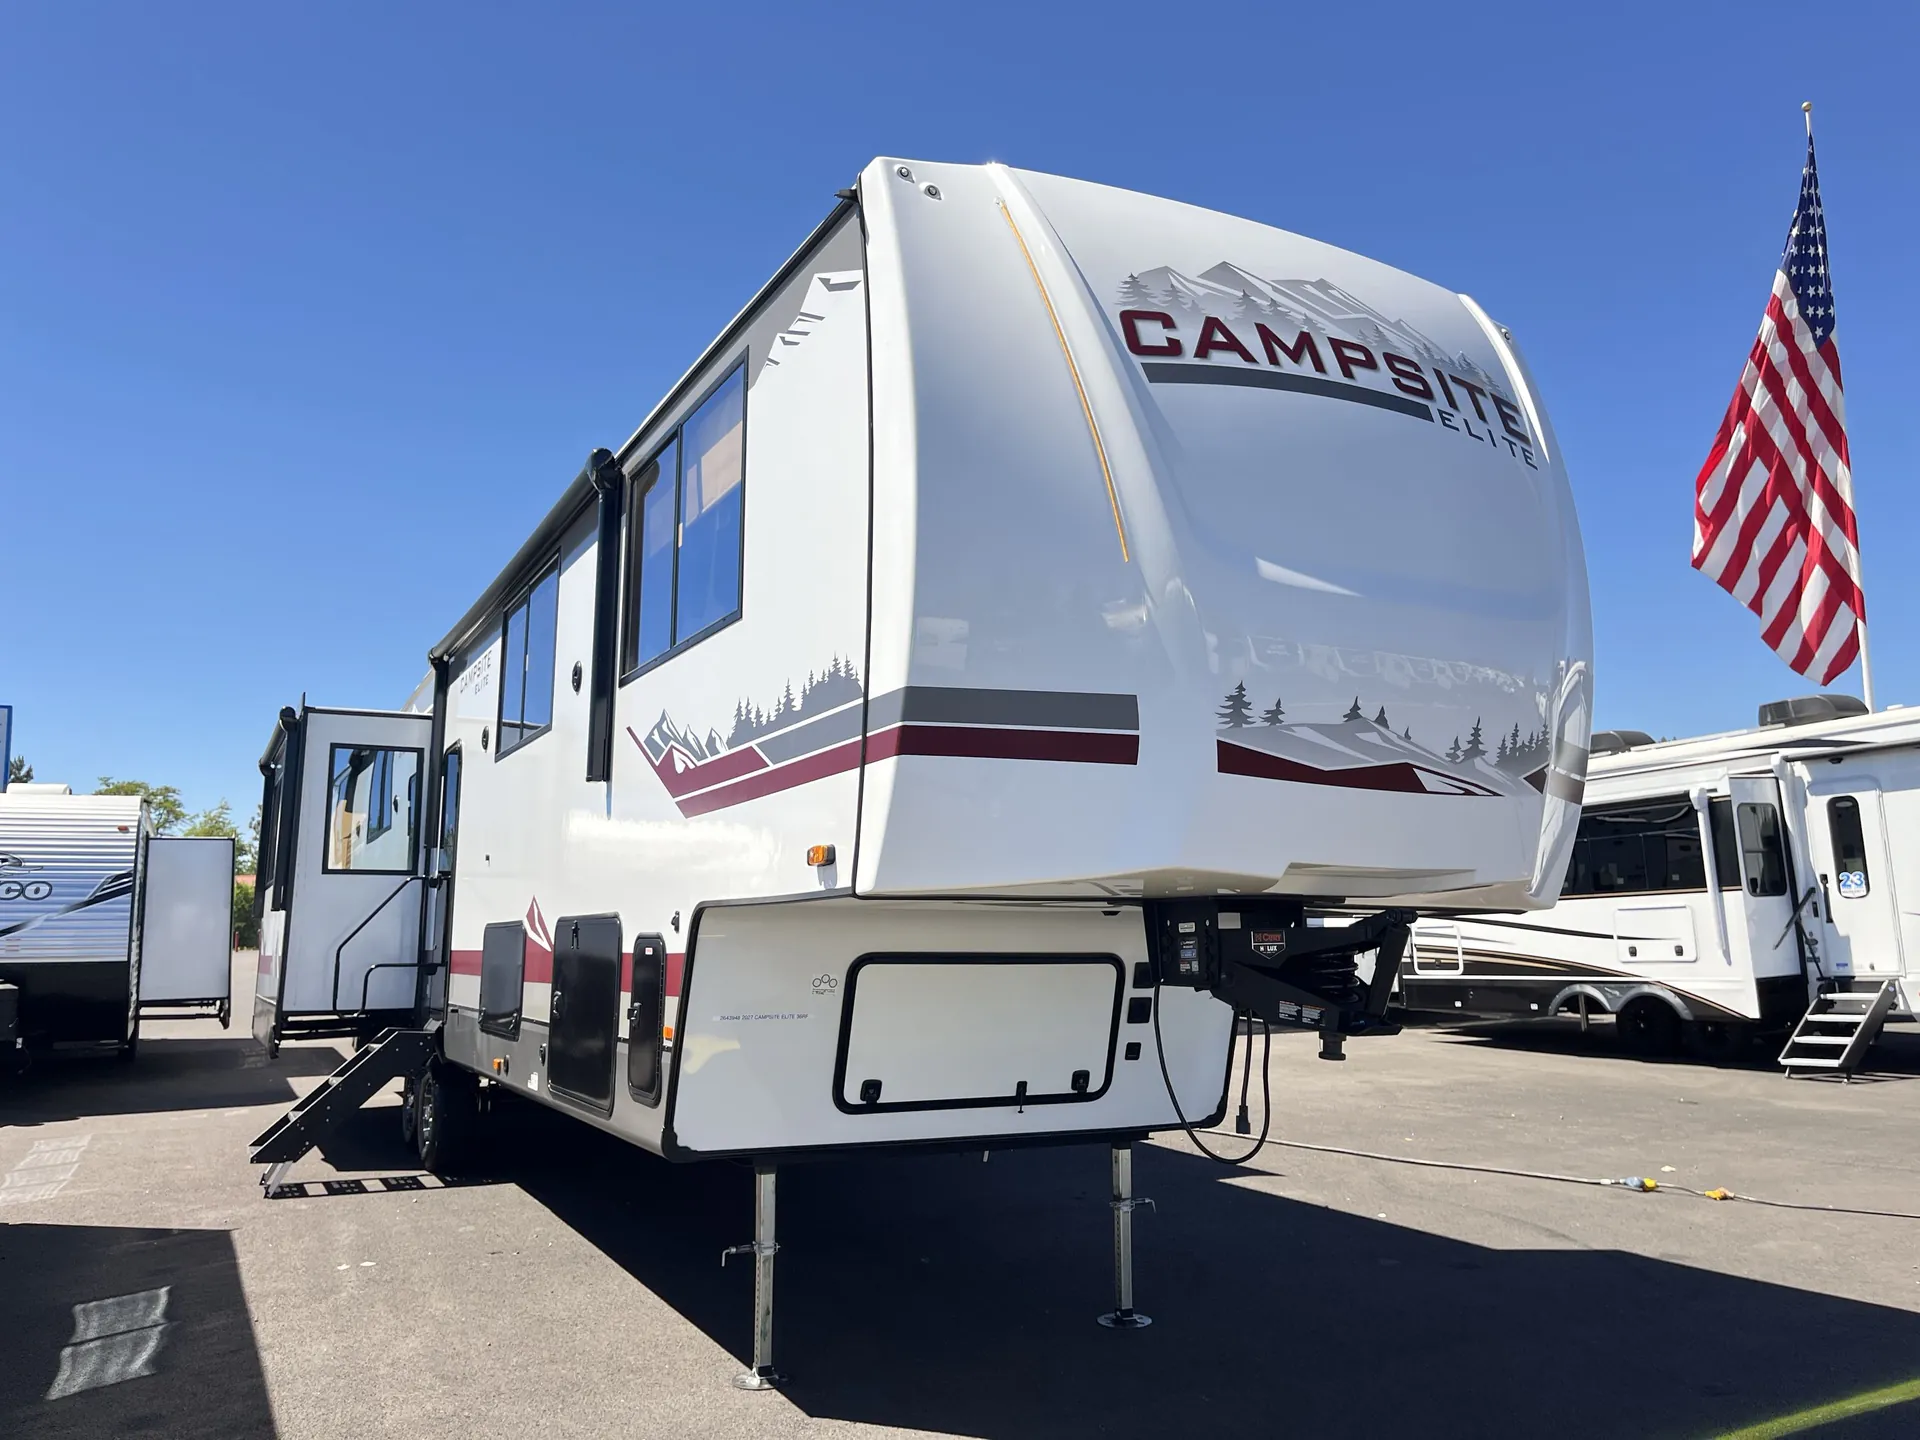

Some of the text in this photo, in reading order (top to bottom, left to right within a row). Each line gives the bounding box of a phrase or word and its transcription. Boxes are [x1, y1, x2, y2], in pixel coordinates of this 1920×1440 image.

[1119, 309, 1533, 447] CAMPSITE
[1436, 408, 1539, 471] ELITE
[460, 650, 492, 693] CAMPSITE
[475, 674, 489, 694] ELITE
[1840, 872, 1864, 888] 23
